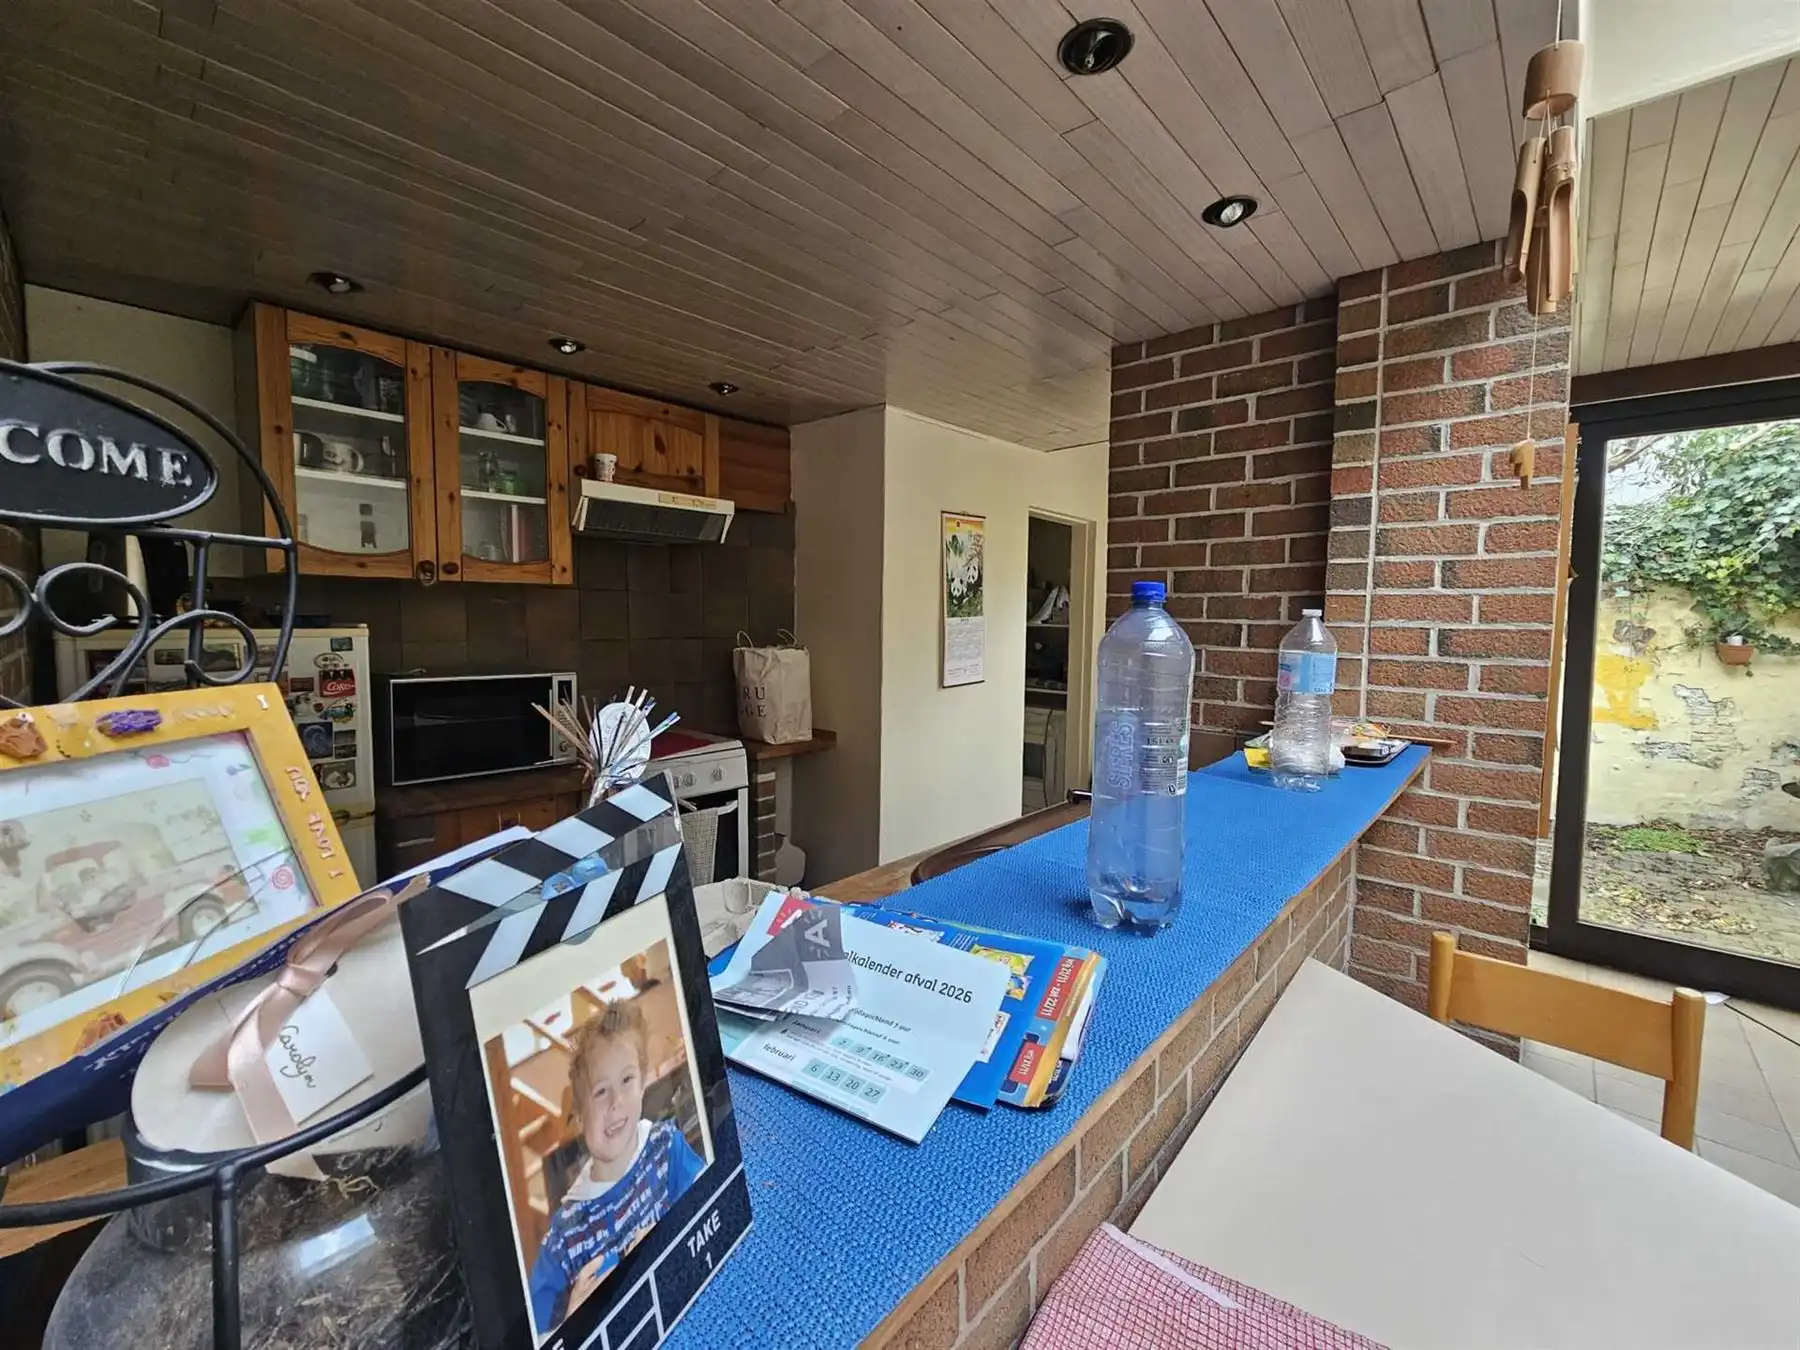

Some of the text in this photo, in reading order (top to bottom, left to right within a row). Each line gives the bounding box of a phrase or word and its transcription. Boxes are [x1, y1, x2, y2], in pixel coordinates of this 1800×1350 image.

[0, 418, 193, 488] COME
[904, 973, 939, 992] afval
[938, 982, 973, 1004] 2026
[278, 1025, 317, 1089] Carolyn
[763, 1042, 881, 1098] februari 6 13 20 27
[910, 1067, 924, 1078] 30
[686, 1208, 721, 1258] TAKE
[704, 1251, 713, 1269] 1
